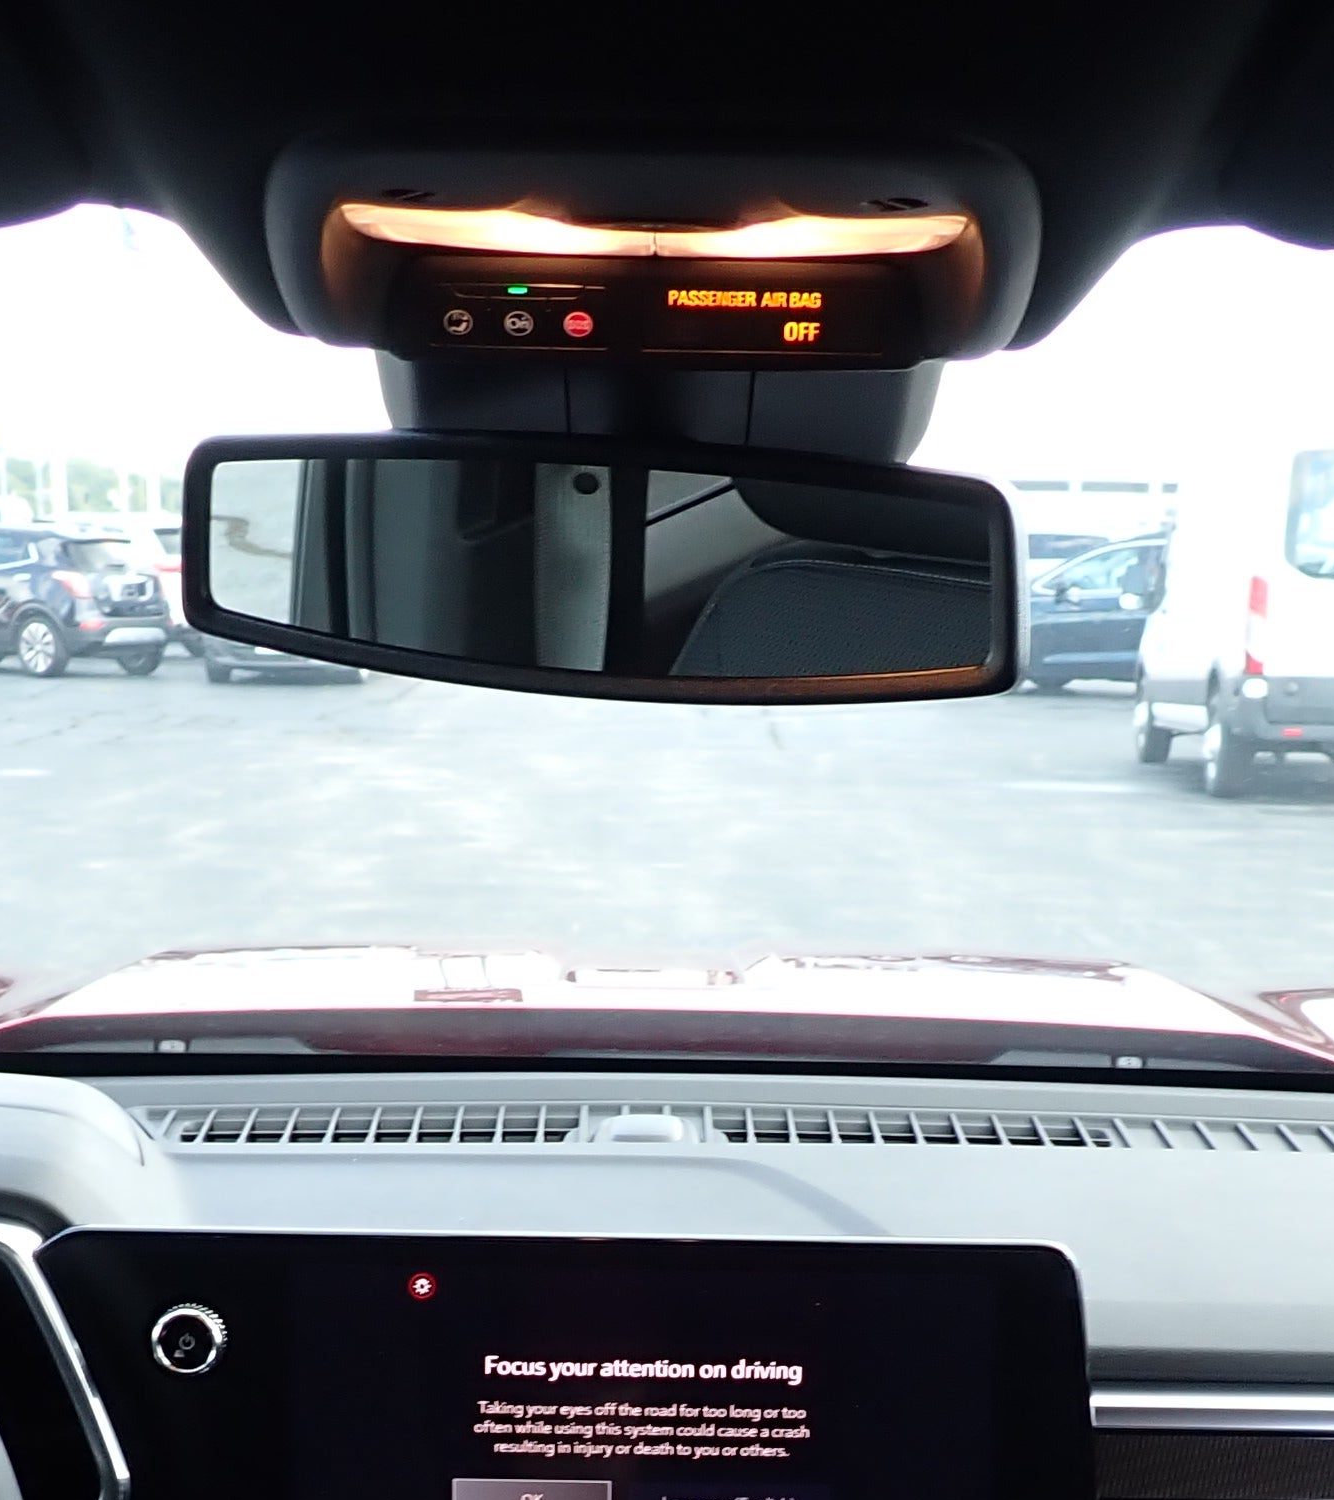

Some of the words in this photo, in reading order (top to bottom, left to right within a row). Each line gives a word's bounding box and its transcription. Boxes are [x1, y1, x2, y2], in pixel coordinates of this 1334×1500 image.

[667, 290, 757, 307] PASSENGER
[760, 291, 788, 308] AIR
[789, 291, 822, 308] BAG
[783, 321, 821, 341] OFF
[484, 1354, 547, 1376] Focus
[548, 1362, 597, 1382] your
[599, 1359, 695, 1379] attention
[699, 1364, 726, 1379] on
[731, 1359, 803, 1385] driving
[477, 1400, 525, 1418] Taking
[525, 1404, 558, 1419] your
[559, 1404, 592, 1419] eyes
[594, 1402, 617, 1416] off
[618, 1402, 642, 1416] the
[644, 1403, 677, 1417] road
[679, 1404, 701, 1418] for
[702, 1406, 727, 1418] too
[729, 1404, 762, 1421] long
[764, 1408, 782, 1418] or
[782, 1407, 807, 1419] too
[473, 1420, 512, 1434] often
[514, 1420, 552, 1435] while
[554, 1422, 594, 1439] using
[595, 1422, 622, 1436] this
[623, 1424, 674, 1440] system
[676, 1424, 715, 1438] could
[717, 1427, 758, 1439] cause
[760, 1428, 770, 1439] a
[771, 1424, 811, 1440] crash
[493, 1440, 555, 1457] resulting
[557, 1441, 572, 1454] in
[573, 1441, 614, 1459] injury
[615, 1445, 632, 1455] or
[633, 1441, 674, 1456] death
[676, 1444, 692, 1456] to
[692, 1446, 720, 1460] you
[721, 1446, 738, 1457] or
[739, 1444, 790, 1458] others.
